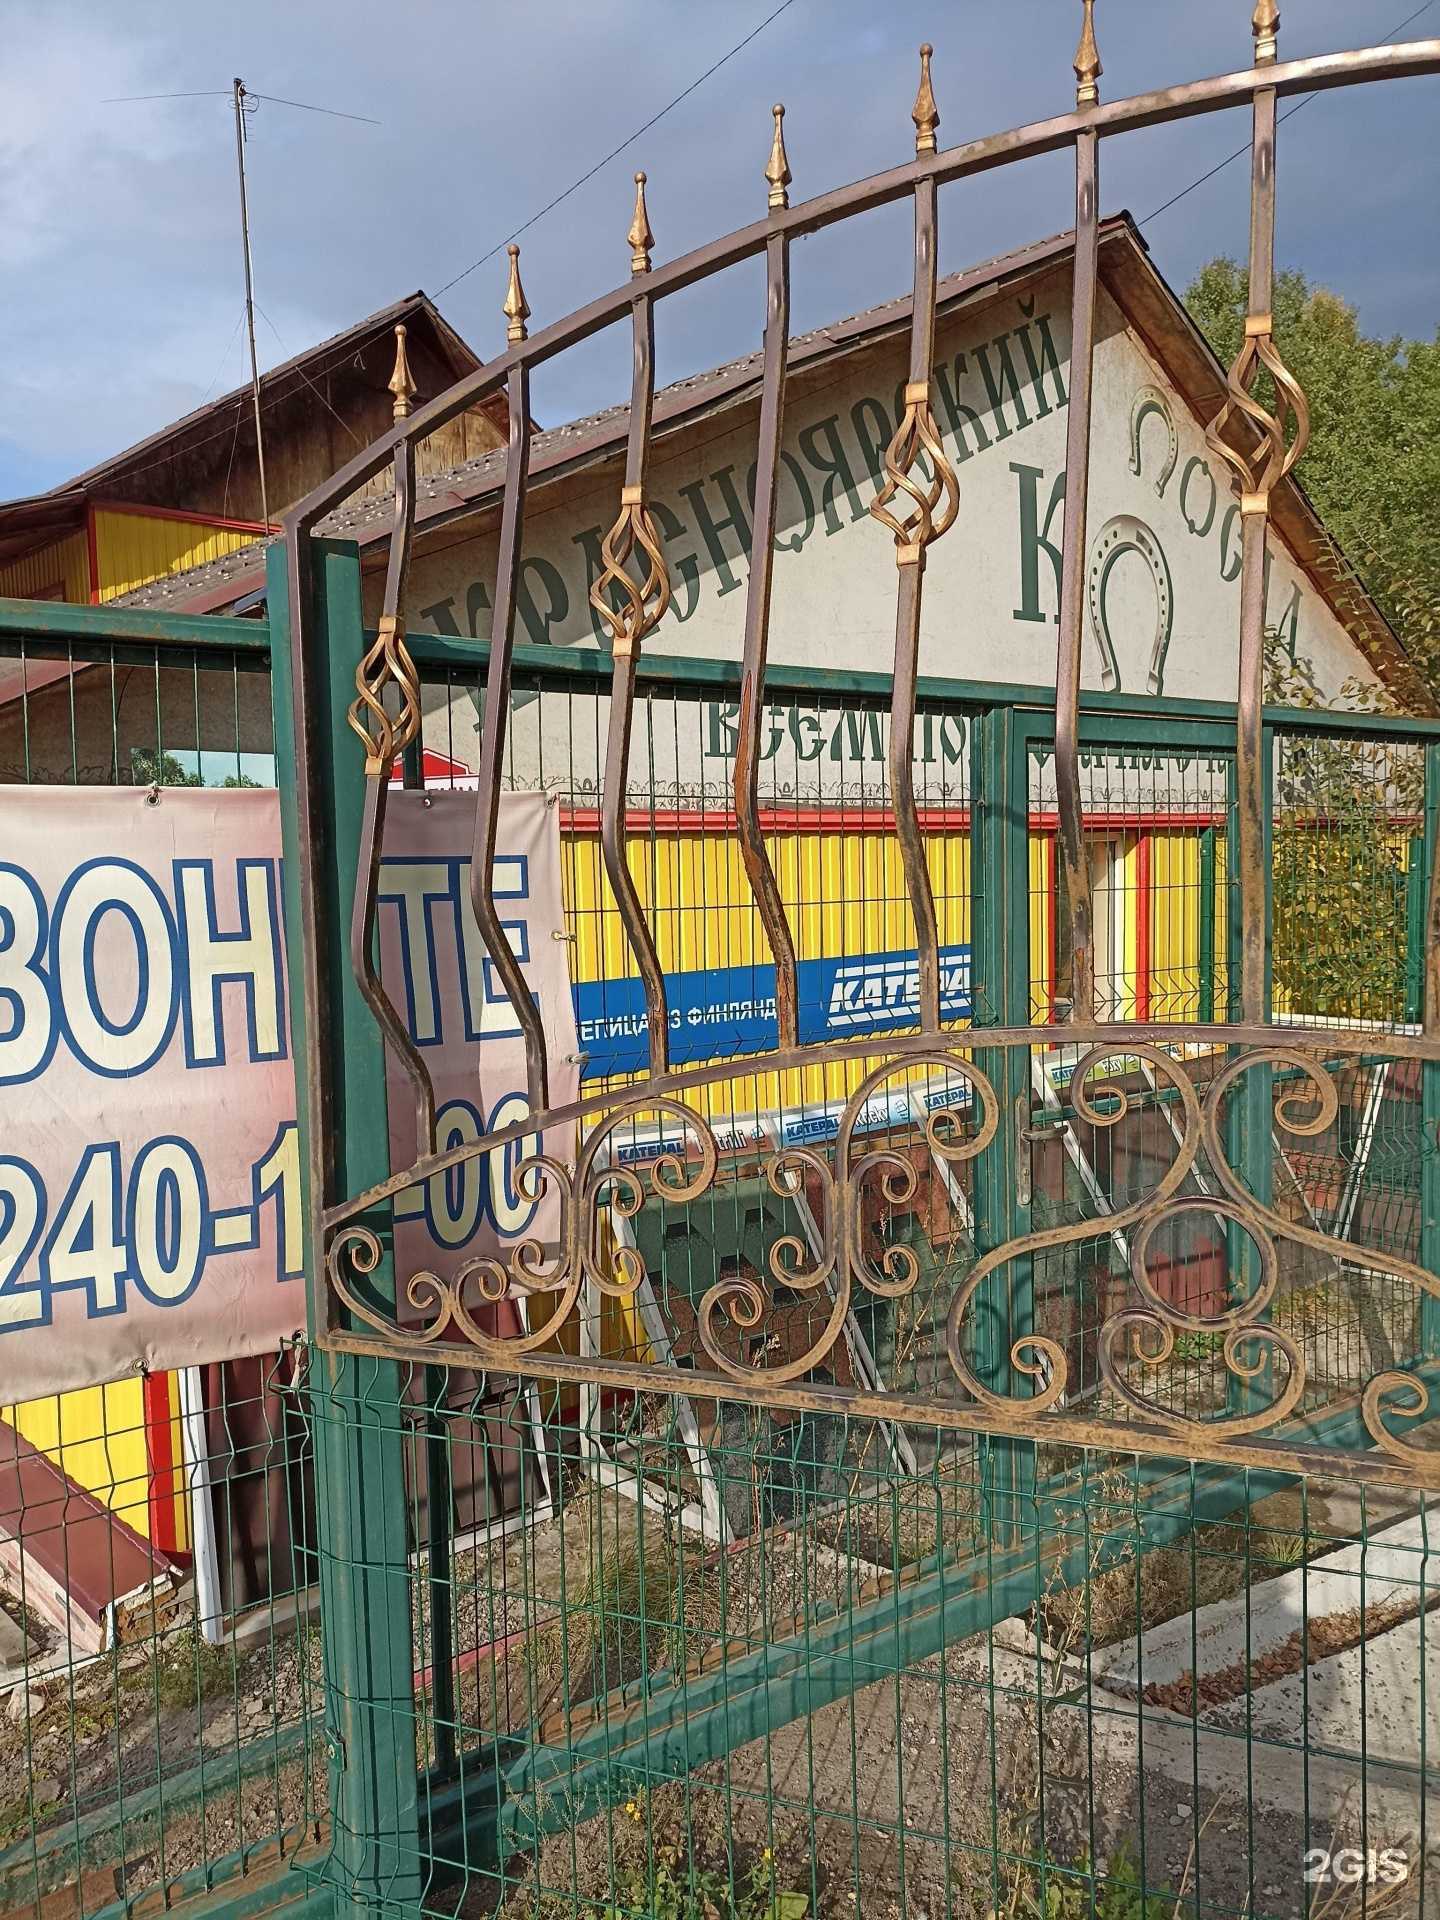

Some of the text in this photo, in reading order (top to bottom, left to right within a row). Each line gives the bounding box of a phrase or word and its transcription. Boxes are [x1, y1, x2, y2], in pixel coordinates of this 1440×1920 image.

[924, 1087, 971, 1107] KATEPAL
[787, 1117, 841, 1138] KATEPAL
[618, 1129, 748, 1162] KATEPAL trilli
